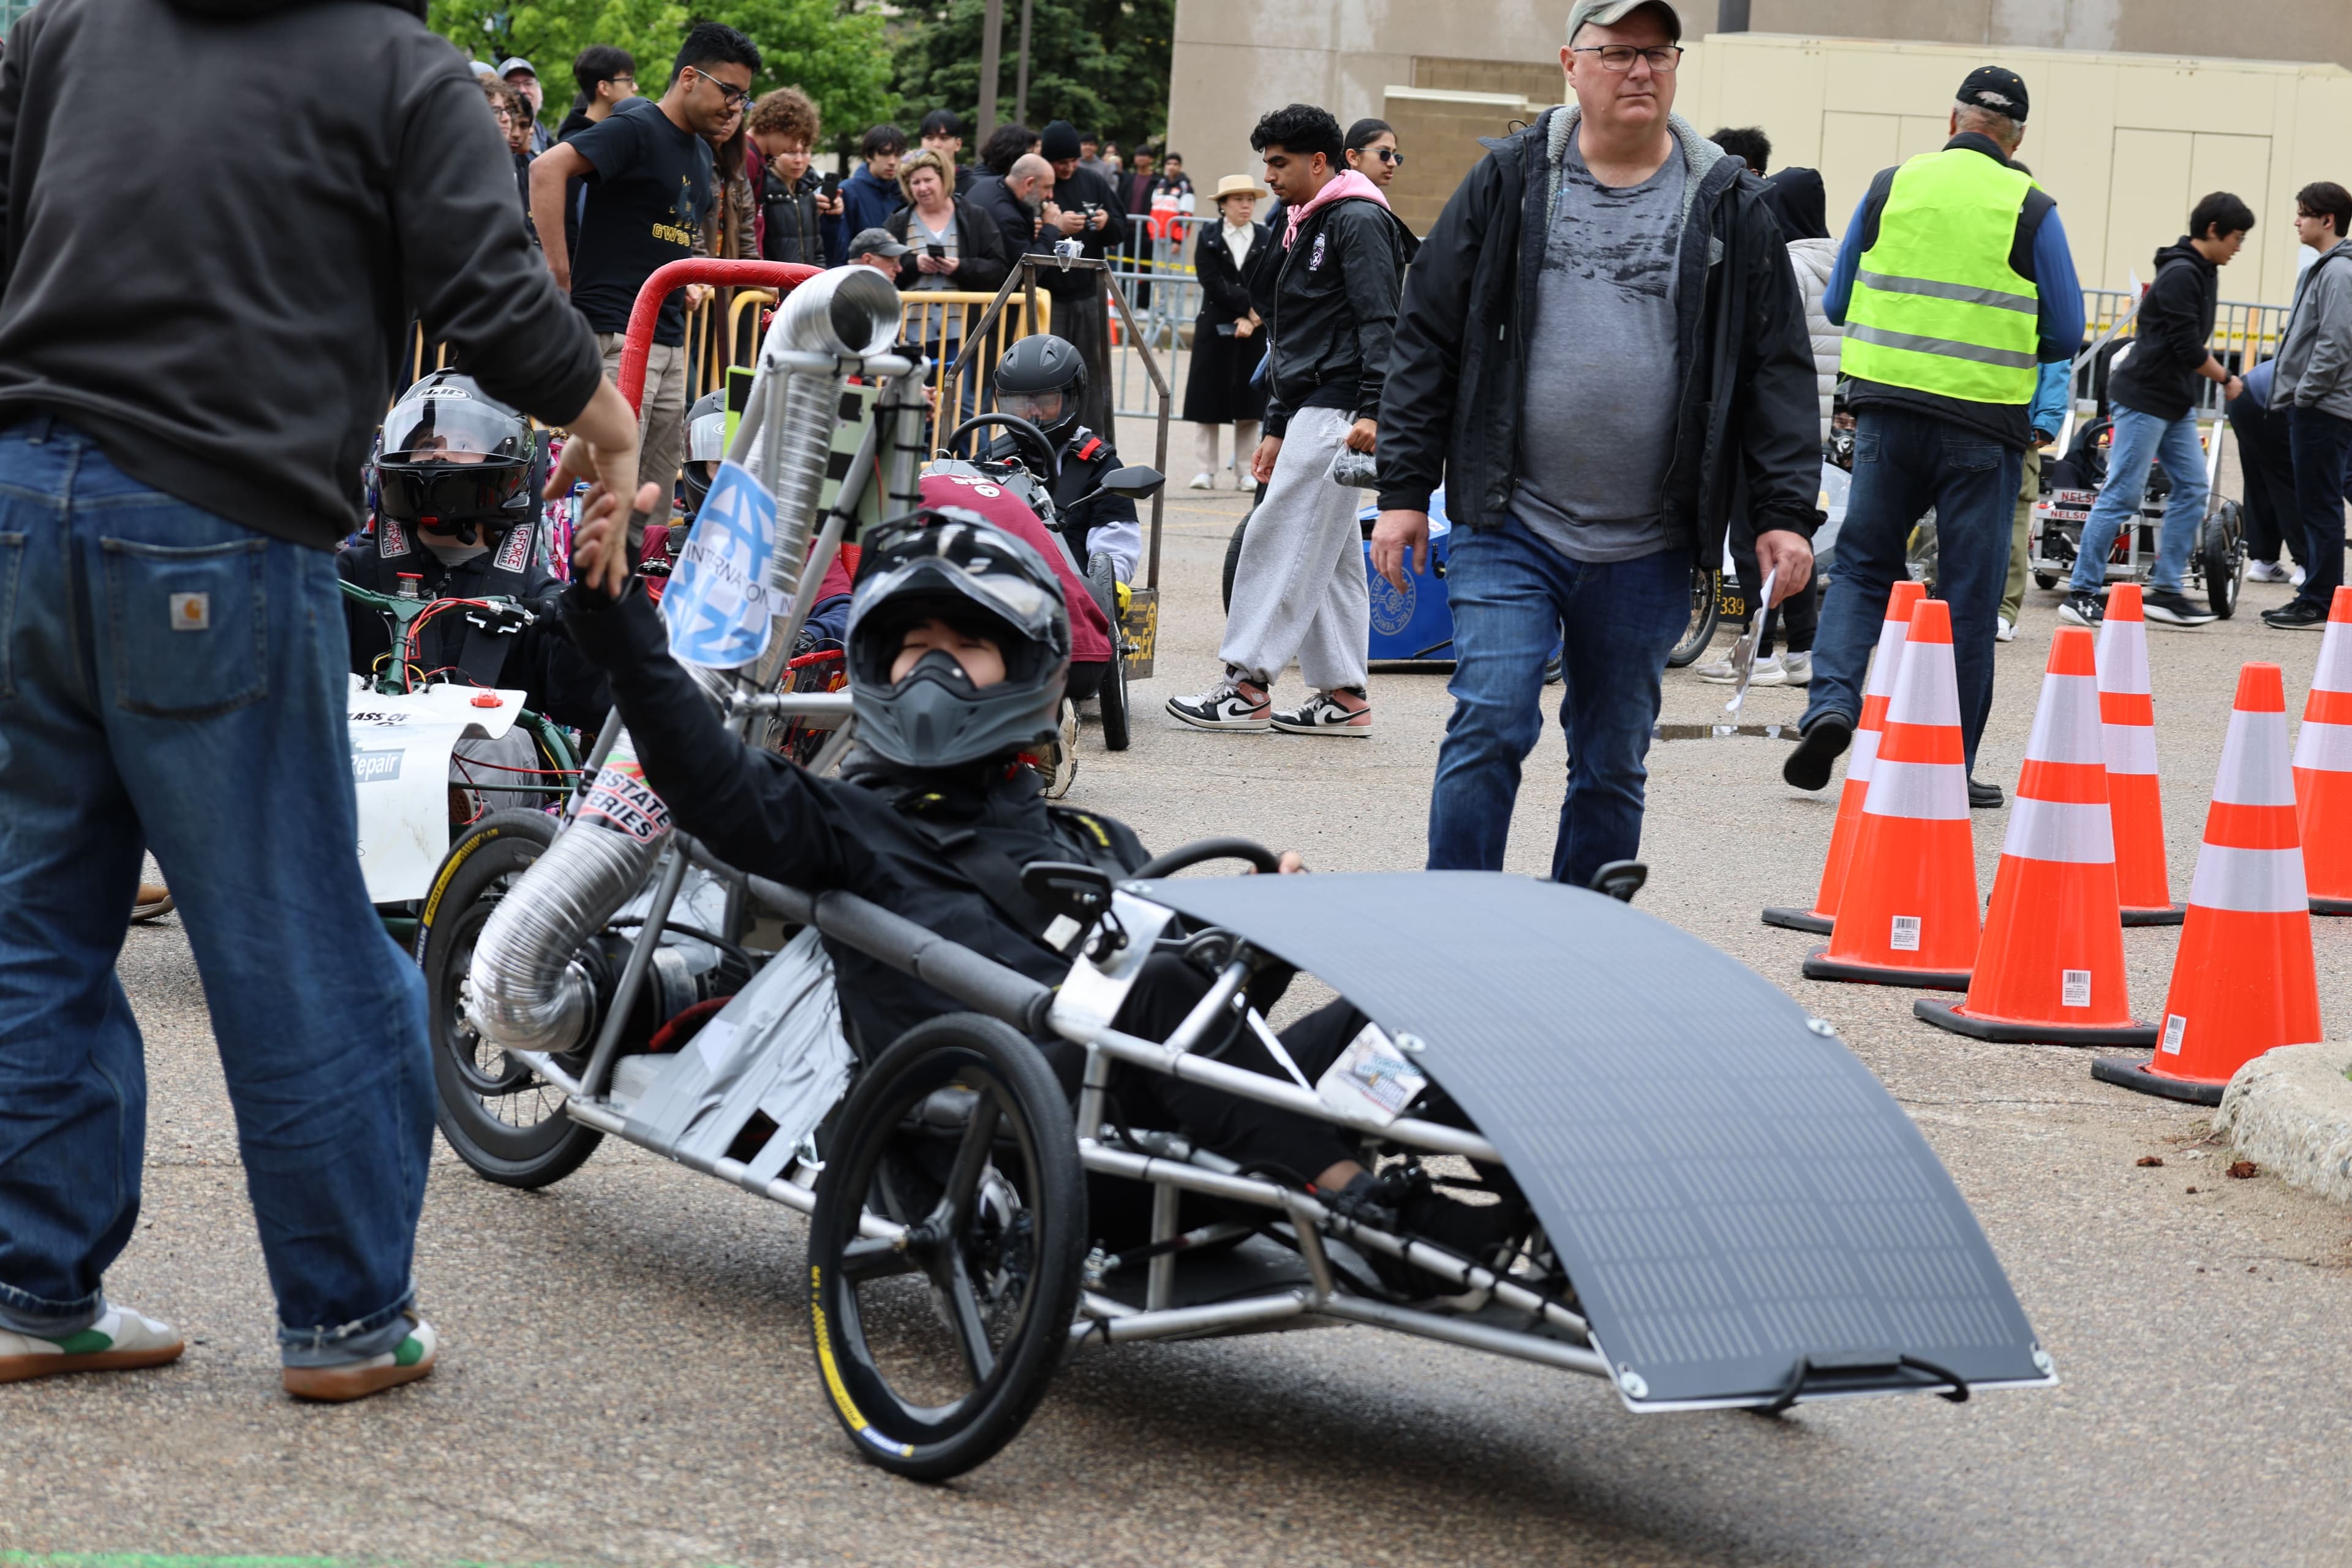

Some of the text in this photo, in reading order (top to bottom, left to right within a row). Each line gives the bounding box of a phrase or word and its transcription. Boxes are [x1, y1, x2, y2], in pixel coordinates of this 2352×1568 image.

[2051, 510, 2087, 520] NELSO
[1371, 577, 1384, 603] CLUB
[1720, 597, 1745, 616] 339
